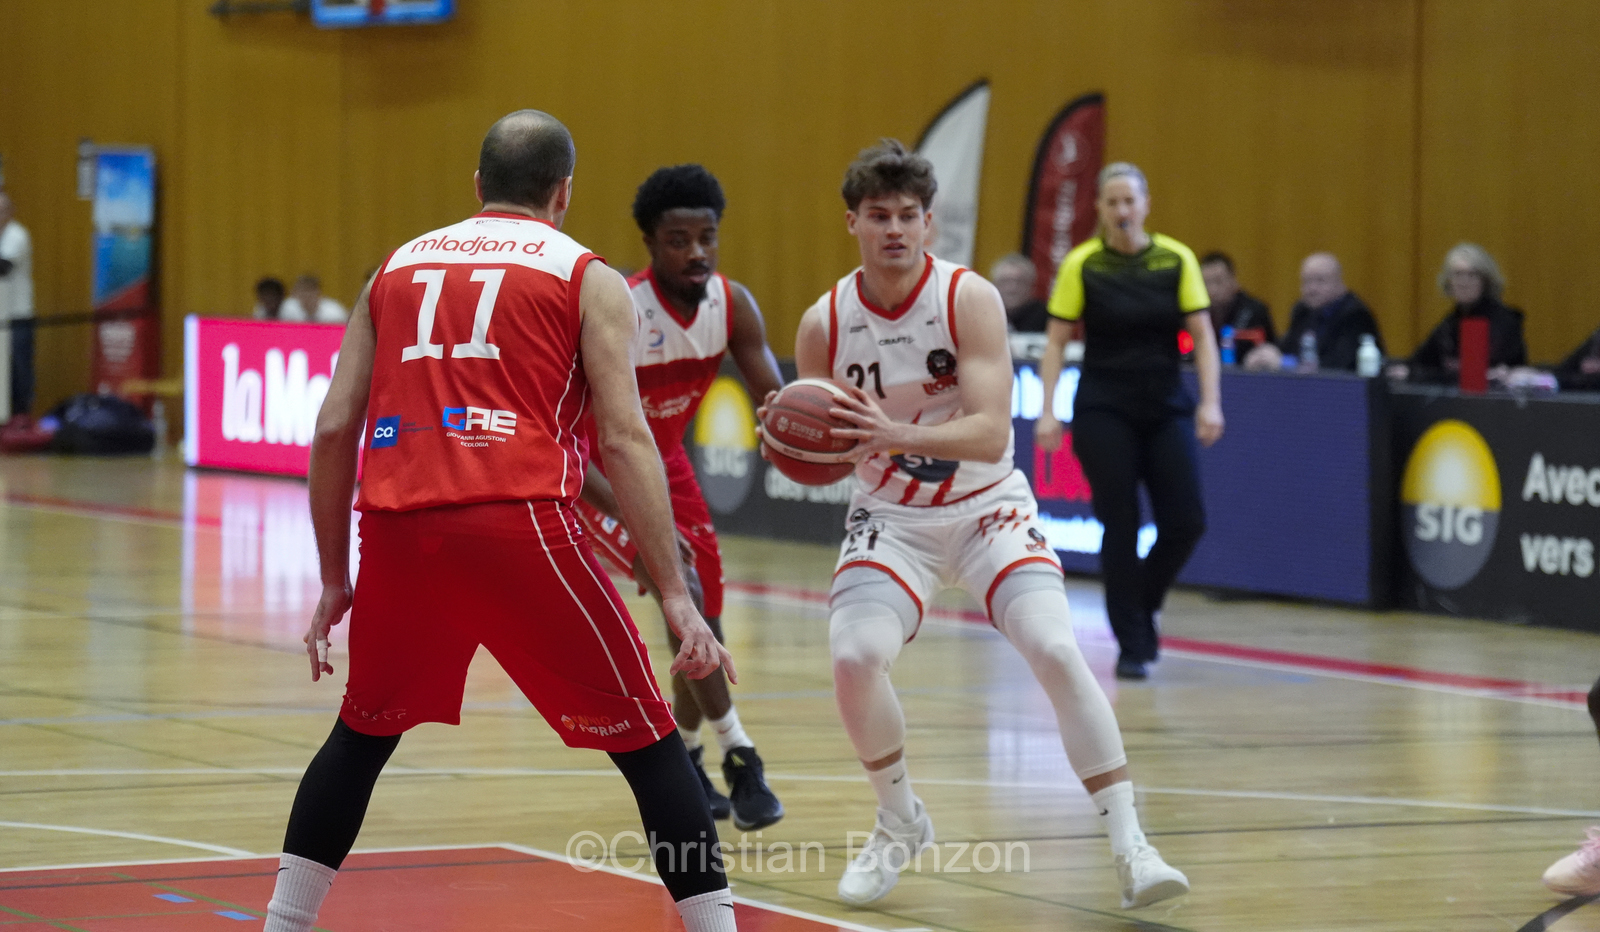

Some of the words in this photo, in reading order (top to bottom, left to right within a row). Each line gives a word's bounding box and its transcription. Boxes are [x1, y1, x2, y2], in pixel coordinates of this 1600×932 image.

[411, 235, 517, 256] mladjan
[522, 241, 545, 257] d.
[401, 269, 506, 363] 11
[847, 361, 887, 399] 21
[442, 406, 517, 436] GAE
[446, 431, 474, 442] GIOVANNI
[475, 435, 507, 443] AGUSTONI
[1521, 452, 1600, 508] Avec
[1414, 502, 1484, 546] SIG
[1520, 532, 1595, 578] vers
